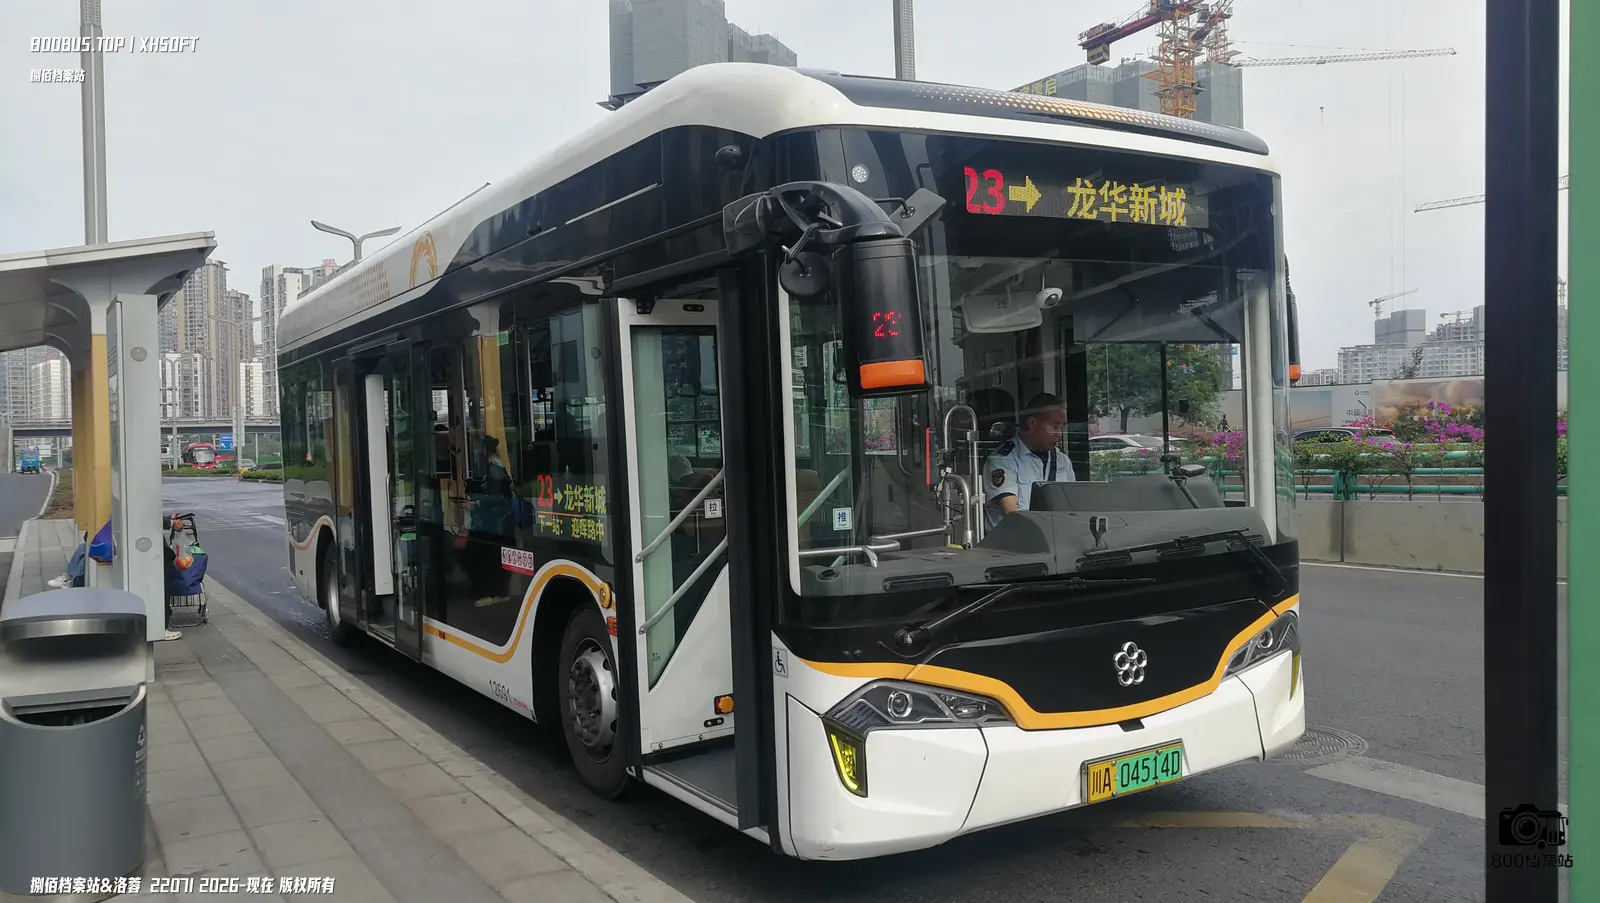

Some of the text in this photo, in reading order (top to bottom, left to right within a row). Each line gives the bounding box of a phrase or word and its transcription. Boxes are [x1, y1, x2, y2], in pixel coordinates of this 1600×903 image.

[964, 166, 1005, 214] 23
[1066, 178, 1187, 226] 龙华新城
[537, 475, 553, 508] 23
[563, 483, 607, 514] 龙华新城
[709, 502, 718, 512] 拉
[838, 511, 847, 522] 推
[1091, 750, 1180, 796] 川A 04514D
